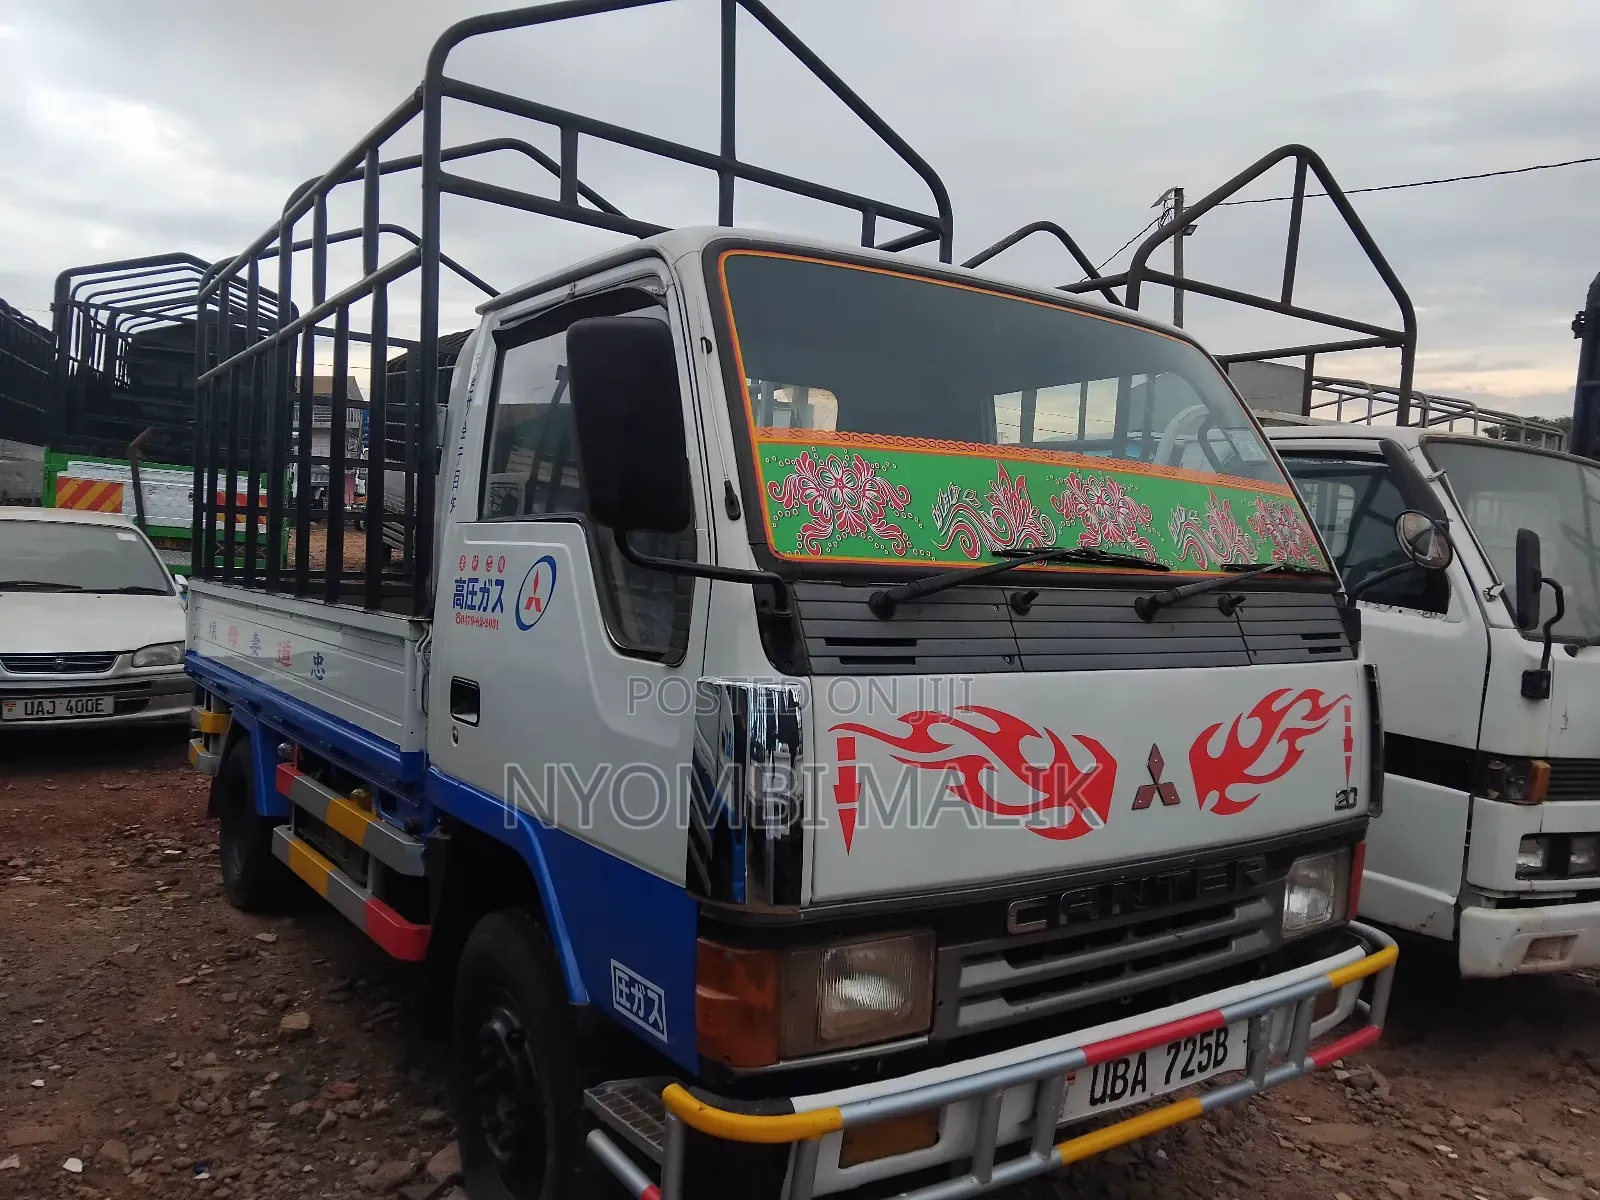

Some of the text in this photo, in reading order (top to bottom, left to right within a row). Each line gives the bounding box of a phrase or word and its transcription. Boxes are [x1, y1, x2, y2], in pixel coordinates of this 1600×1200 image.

[453, 577, 505, 614] 高圧ガス
[275, 640, 293, 668] 道
[310, 652, 326, 681] 忠
[24, 698, 104, 716] UAJ 400E
[1335, 786, 1358, 811] 20
[1007, 855, 1267, 935] CANTER
[615, 968, 663, 1031] 圧ガス
[1088, 1026, 1229, 1107] UBA 725B
